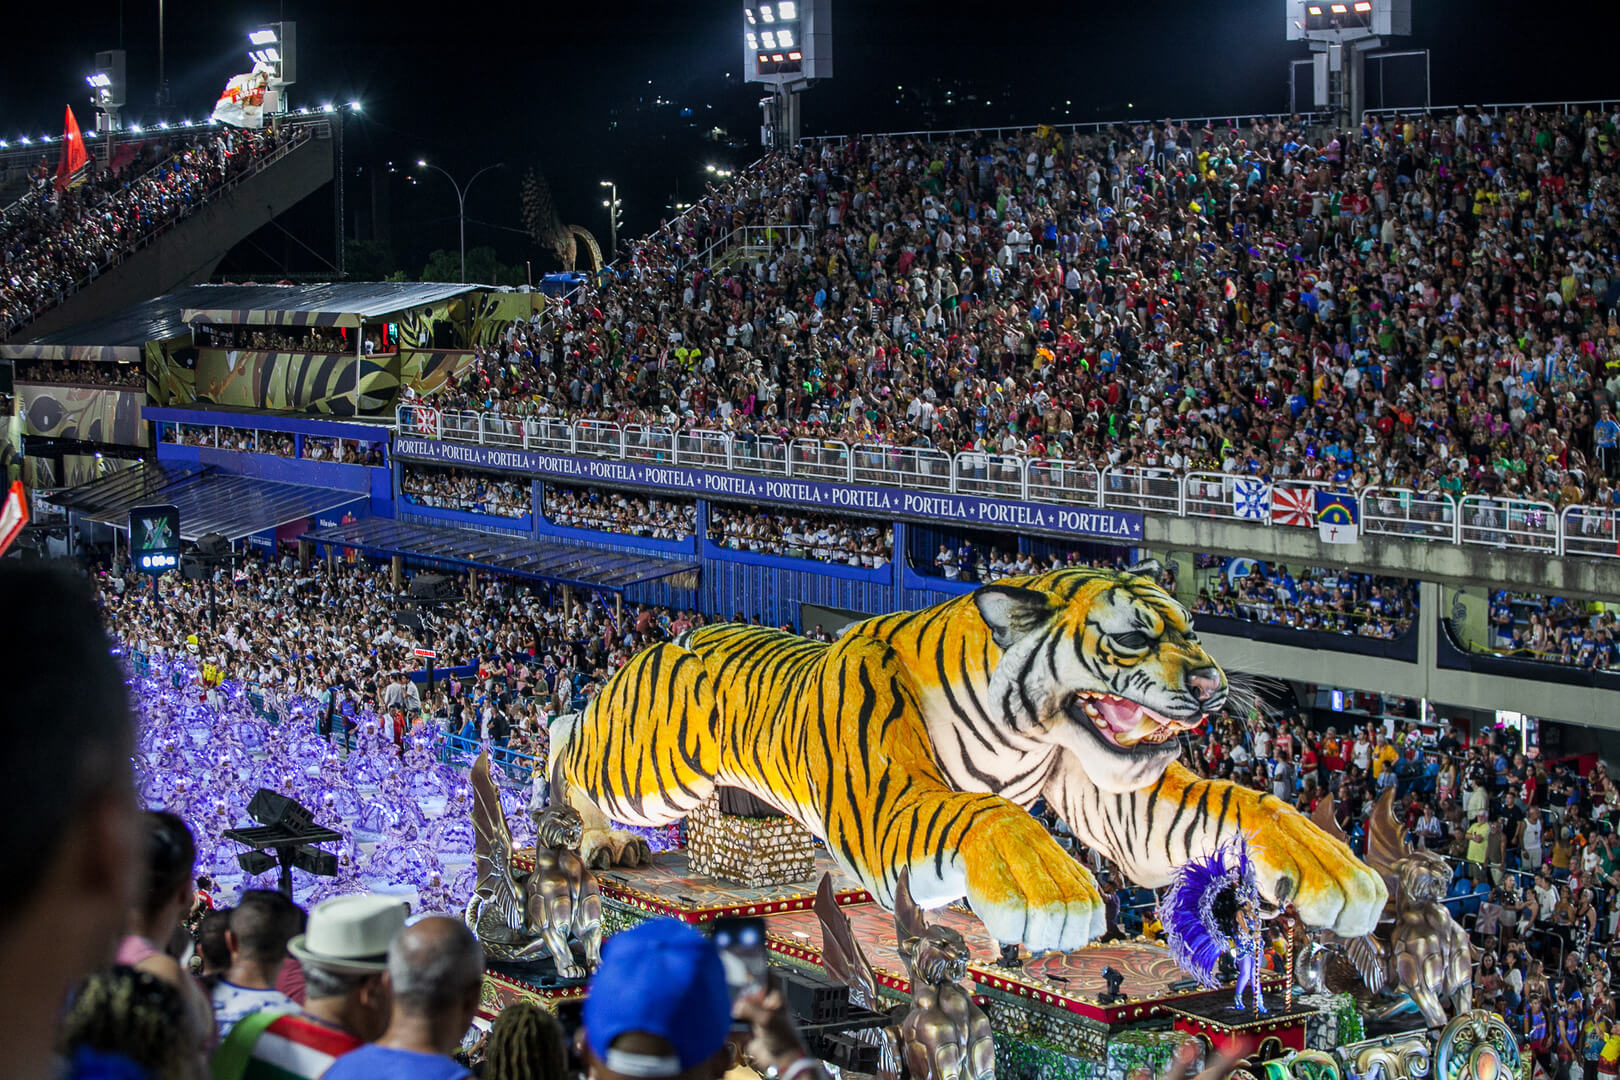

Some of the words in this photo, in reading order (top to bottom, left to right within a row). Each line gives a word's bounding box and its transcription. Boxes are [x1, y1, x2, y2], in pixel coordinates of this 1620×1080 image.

[397, 439, 435, 456] PORTELA
[441, 444, 480, 462] PORTELA
[488, 451, 529, 468] PORTELA
[539, 456, 581, 474] PORTELA
[590, 462, 636, 481] PORTELA
[645, 468, 694, 487] PORTELA
[705, 474, 756, 495] PORTELA
[766, 481, 821, 502] PORTELA
[832, 488, 890, 509] PORTELA
[904, 494, 966, 518] PORTELA
[978, 502, 1045, 526] PORTELA
[1058, 510, 1130, 535] PORTELA
